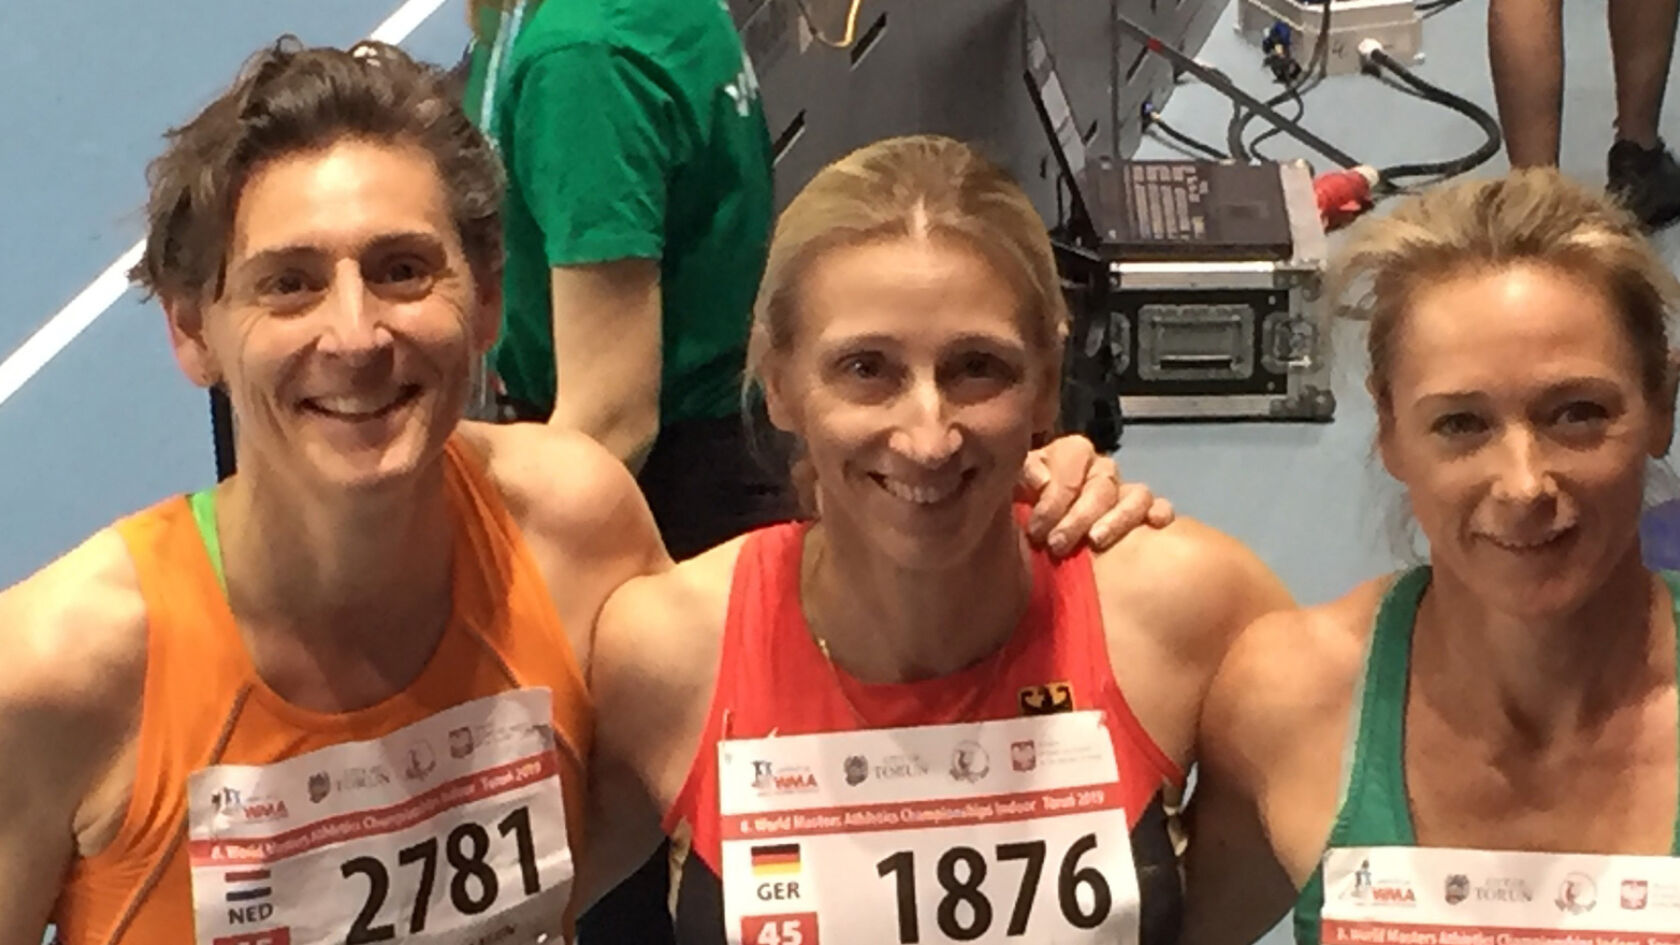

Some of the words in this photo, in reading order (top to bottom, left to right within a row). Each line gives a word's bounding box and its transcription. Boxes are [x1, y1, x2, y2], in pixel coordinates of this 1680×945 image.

[774, 775, 817, 788] WMA
[755, 817, 791, 832] World
[793, 814, 842, 829] Masters
[844, 810, 898, 826] Athletics
[900, 803, 993, 824] Championships
[995, 800, 1036, 816] Indoor
[1078, 790, 1105, 807] 2019
[340, 806, 539, 945] 2781
[757, 882, 799, 901] GER
[876, 833, 1112, 944] 1876
[1373, 888, 1415, 902] WMA
[228, 903, 273, 924] NED
[757, 920, 803, 945] 45
[1350, 927, 1385, 943] World
[1387, 928, 1437, 945] Masters
